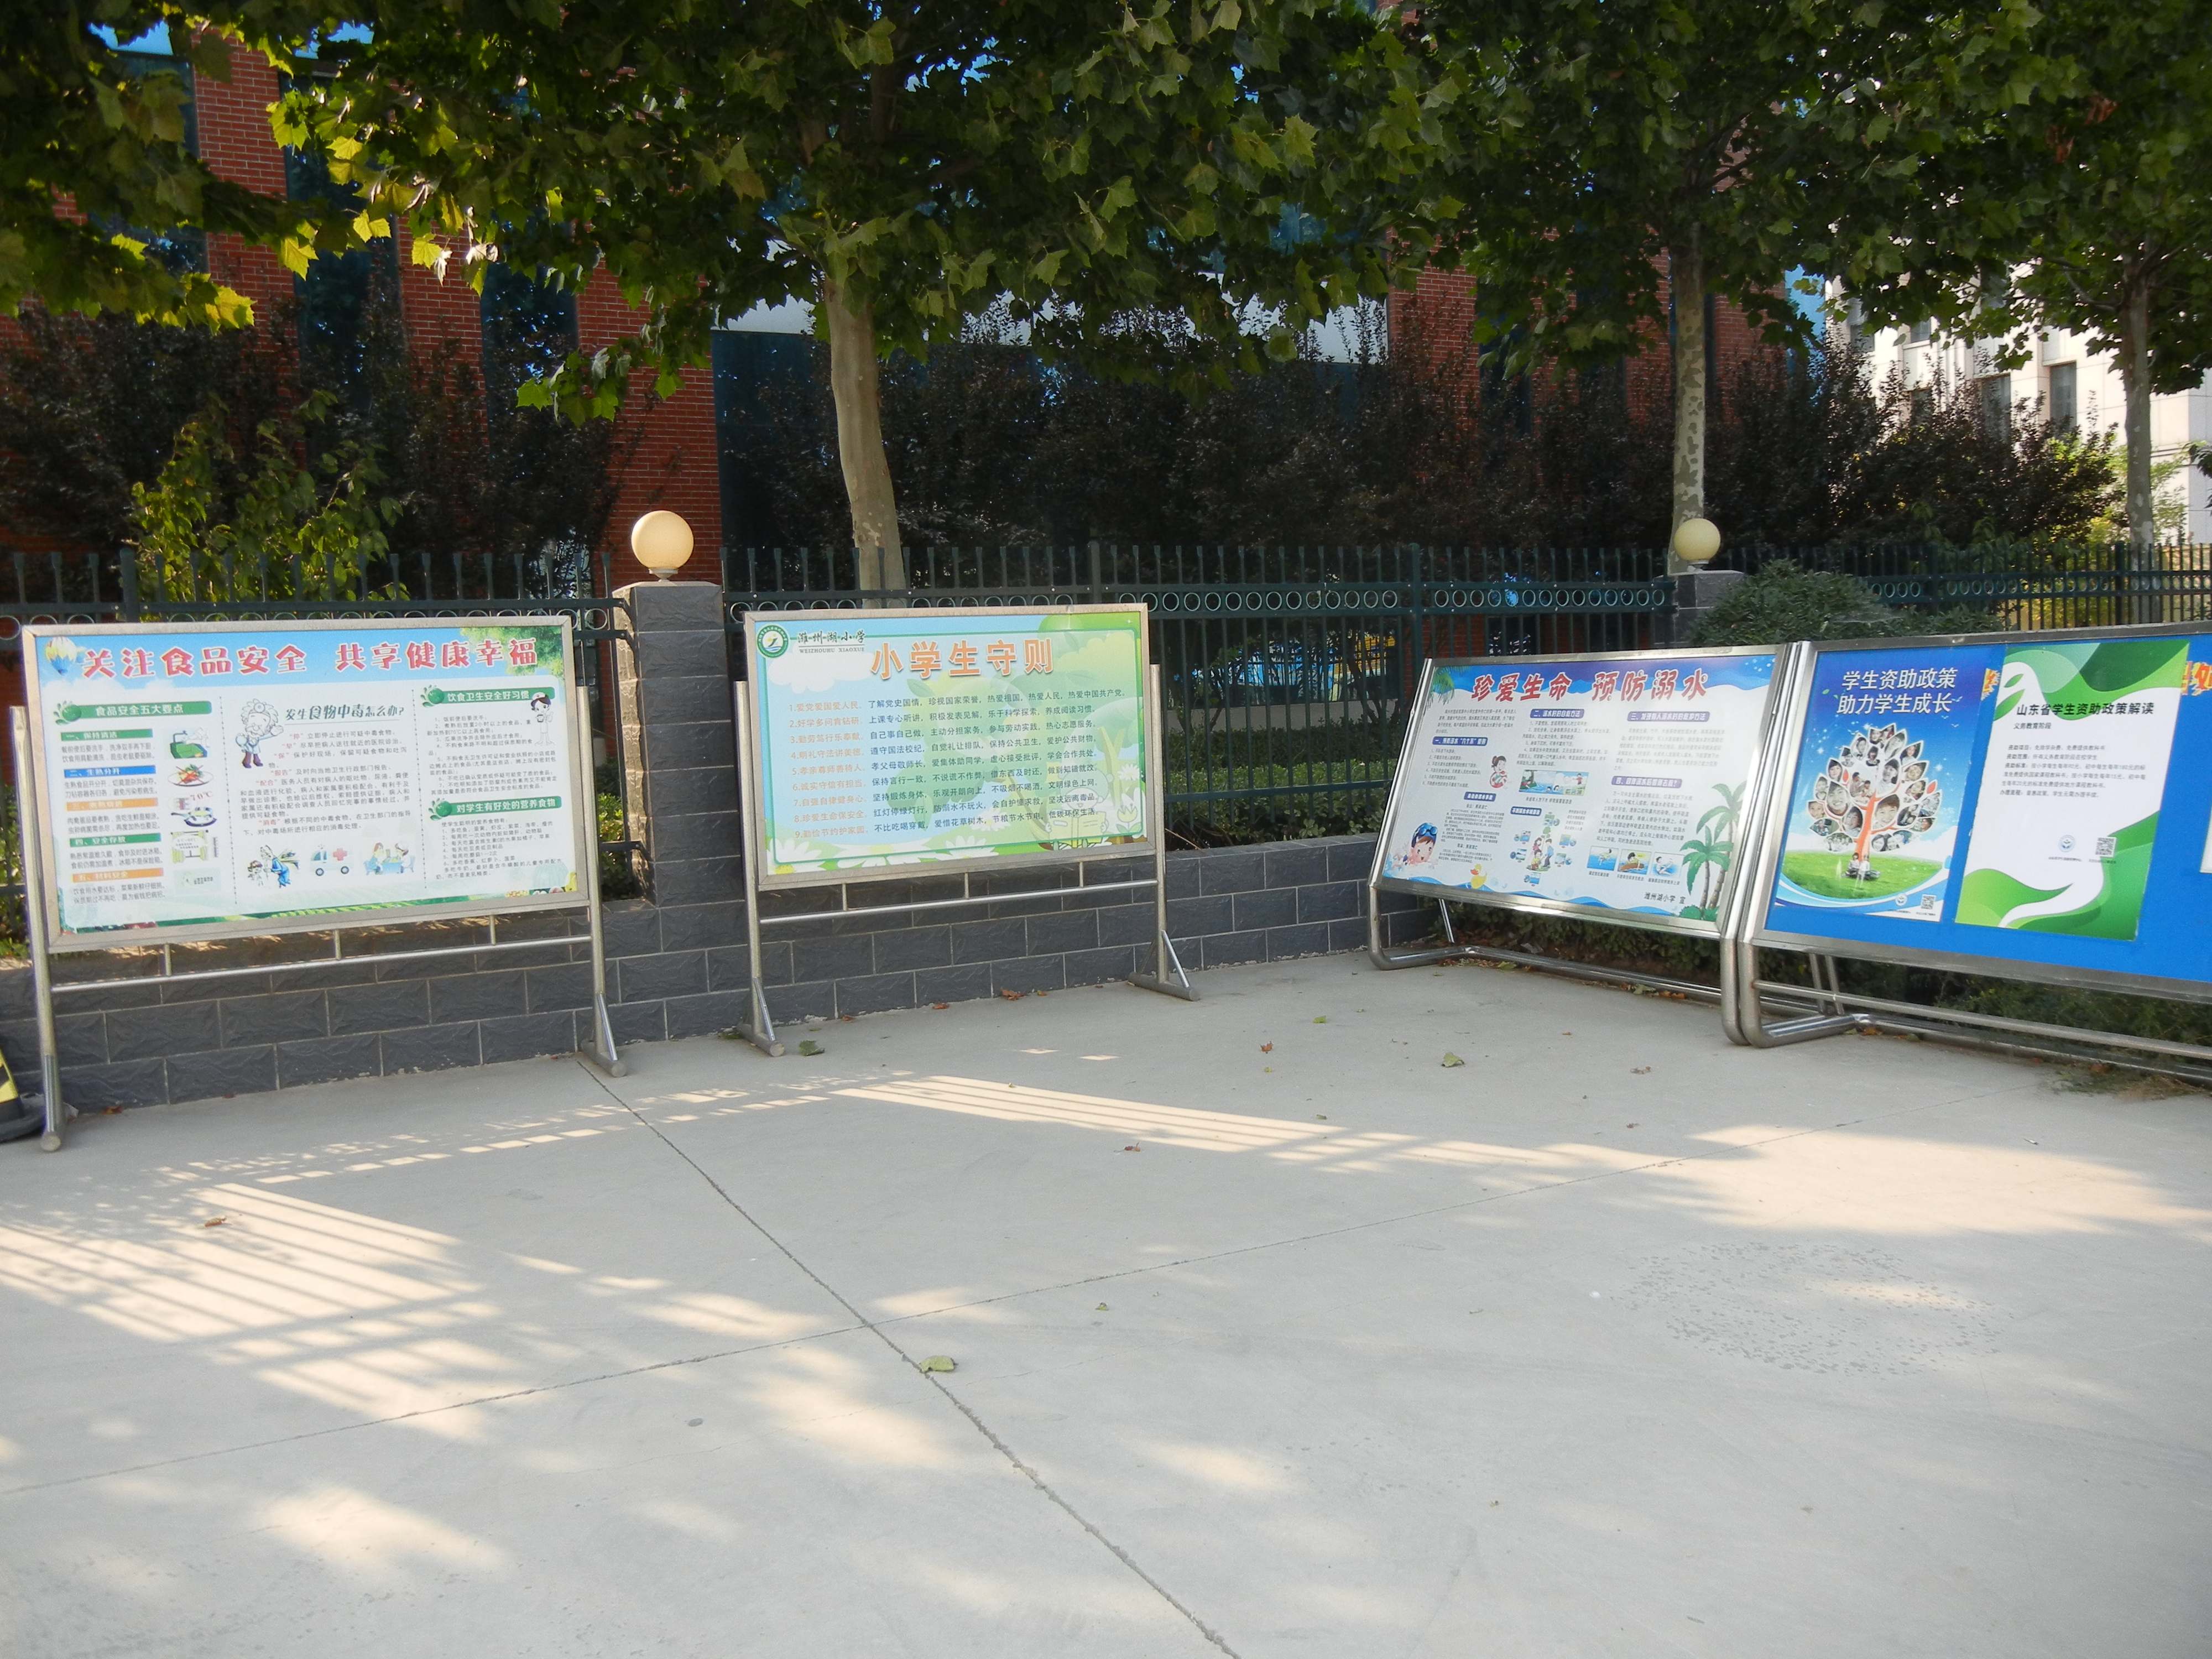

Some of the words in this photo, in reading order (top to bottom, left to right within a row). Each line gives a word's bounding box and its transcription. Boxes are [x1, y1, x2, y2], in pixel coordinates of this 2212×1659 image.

[81, 644, 307, 680] 关注食品安全
[334, 637, 540, 672] 共享健康幸福
[870, 638, 1054, 680] 小学生守则
[1471, 672, 1572, 702] 珍爱生命
[1592, 667, 1708, 702] 预防溺水
[1841, 667, 1959, 691] 学生资助政策
[447, 691, 530, 702] 饮食卫生安全好习惯
[1837, 692, 1953, 714] 助力学生成长
[96, 703, 184, 717] 食品安全五大要点
[2016, 702, 2154, 716] 山东省学生资助政策解读
[457, 798, 556, 813] 对学生有好处的营养食物
